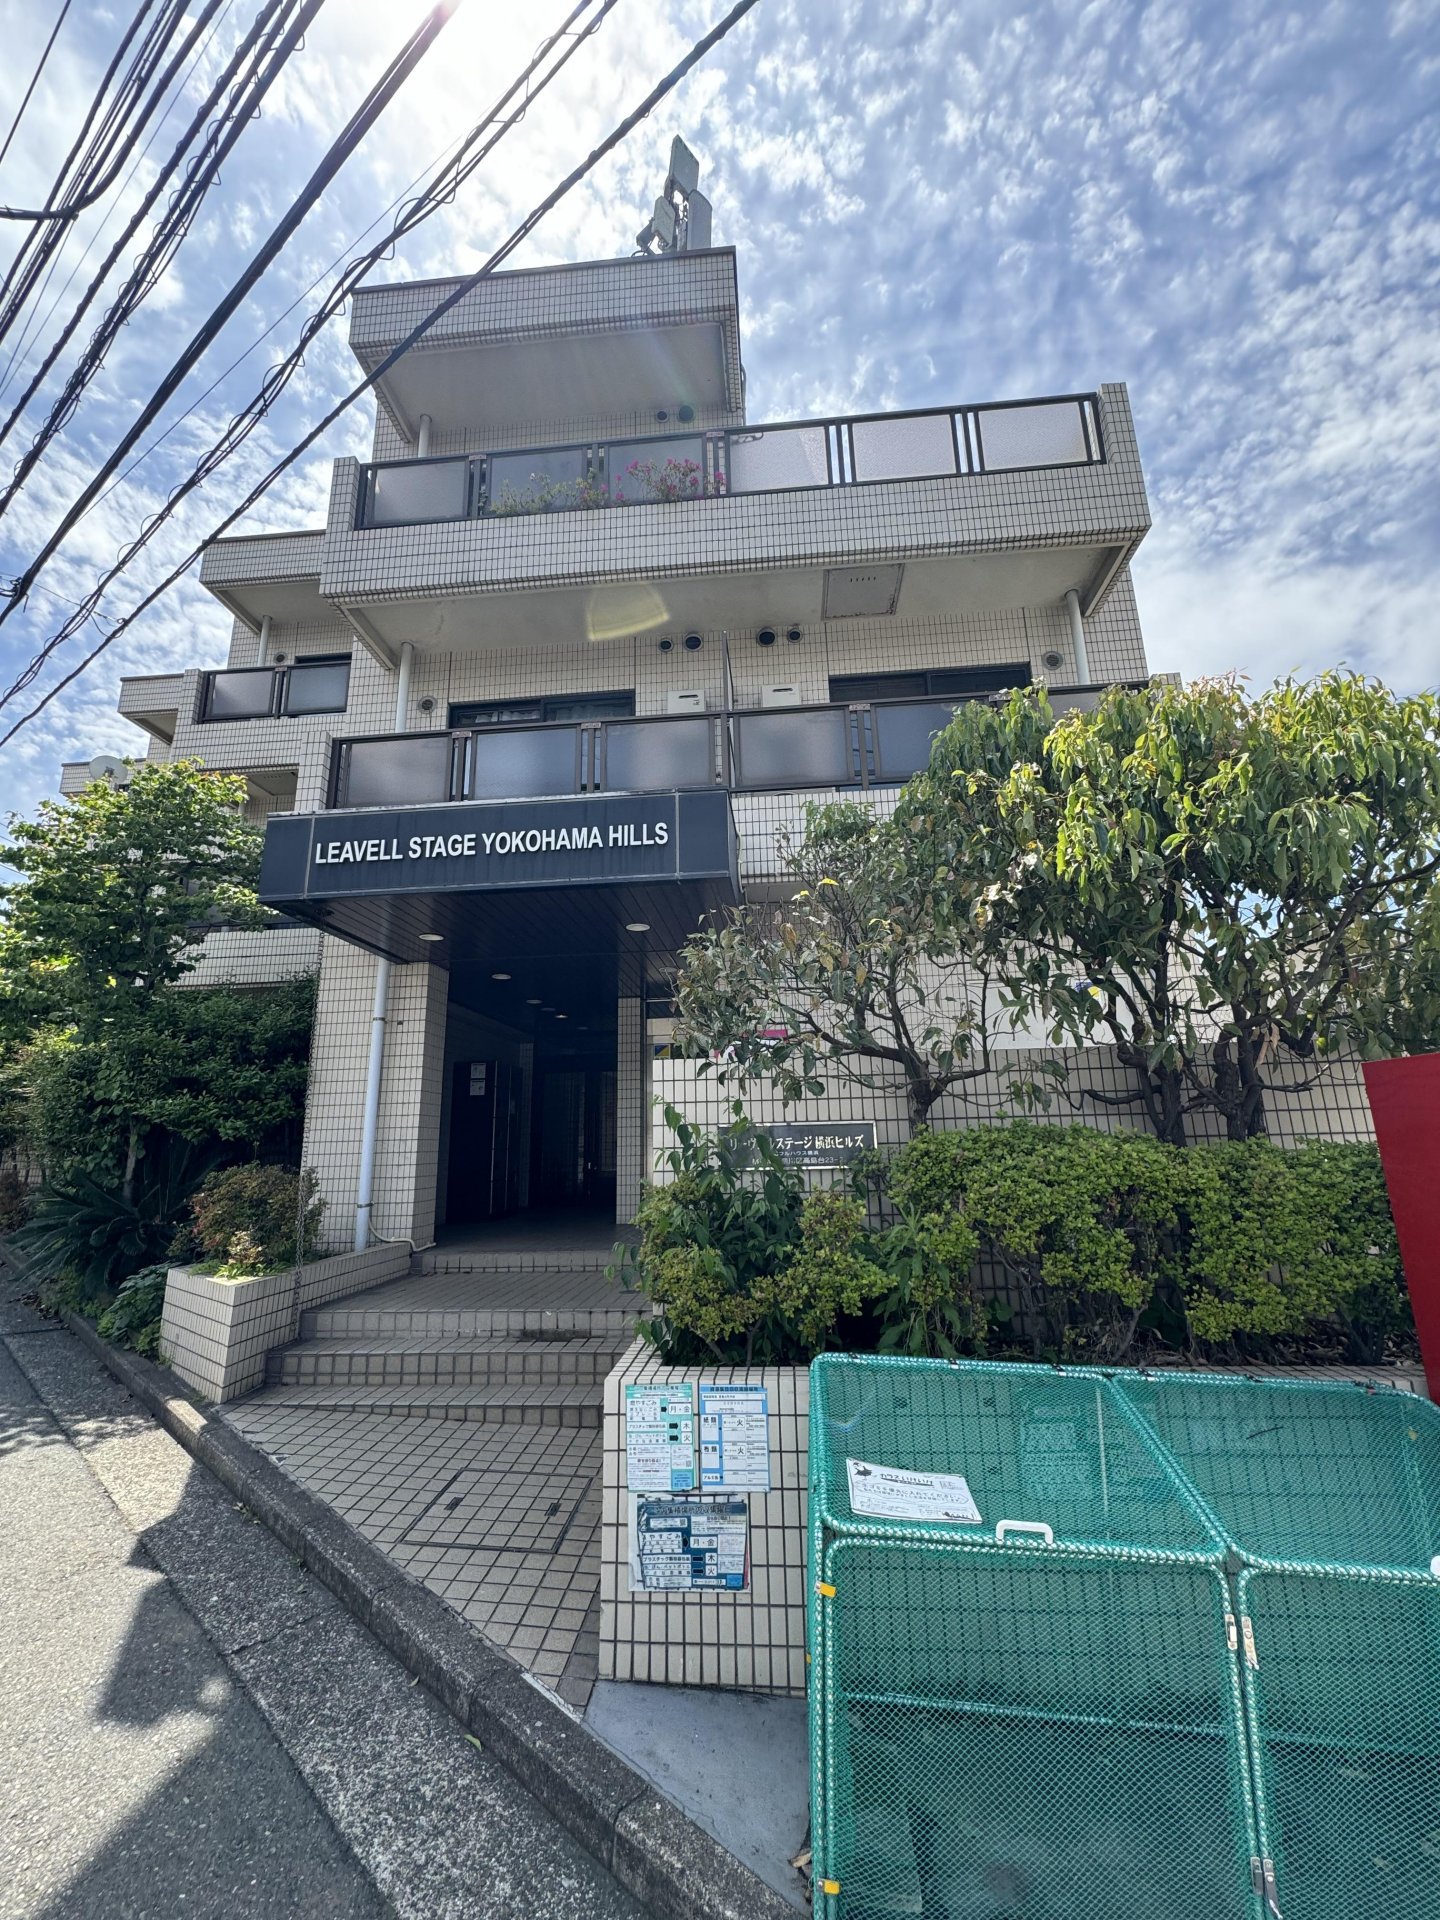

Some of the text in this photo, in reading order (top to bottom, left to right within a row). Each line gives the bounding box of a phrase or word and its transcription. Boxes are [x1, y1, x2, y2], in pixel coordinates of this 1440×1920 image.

[316, 822, 668, 864] LEAVELL STAGE YOKOHAMA HILLS
[683, 1422, 690, 1430] 木
[737, 1418, 744, 1426] 火
[683, 1434, 690, 1442] 火
[737, 1446, 745, 1455] 火
[693, 1538, 715, 1547] 月・金
[707, 1554, 716, 1562] 木
[707, 1566, 716, 1575] 火
